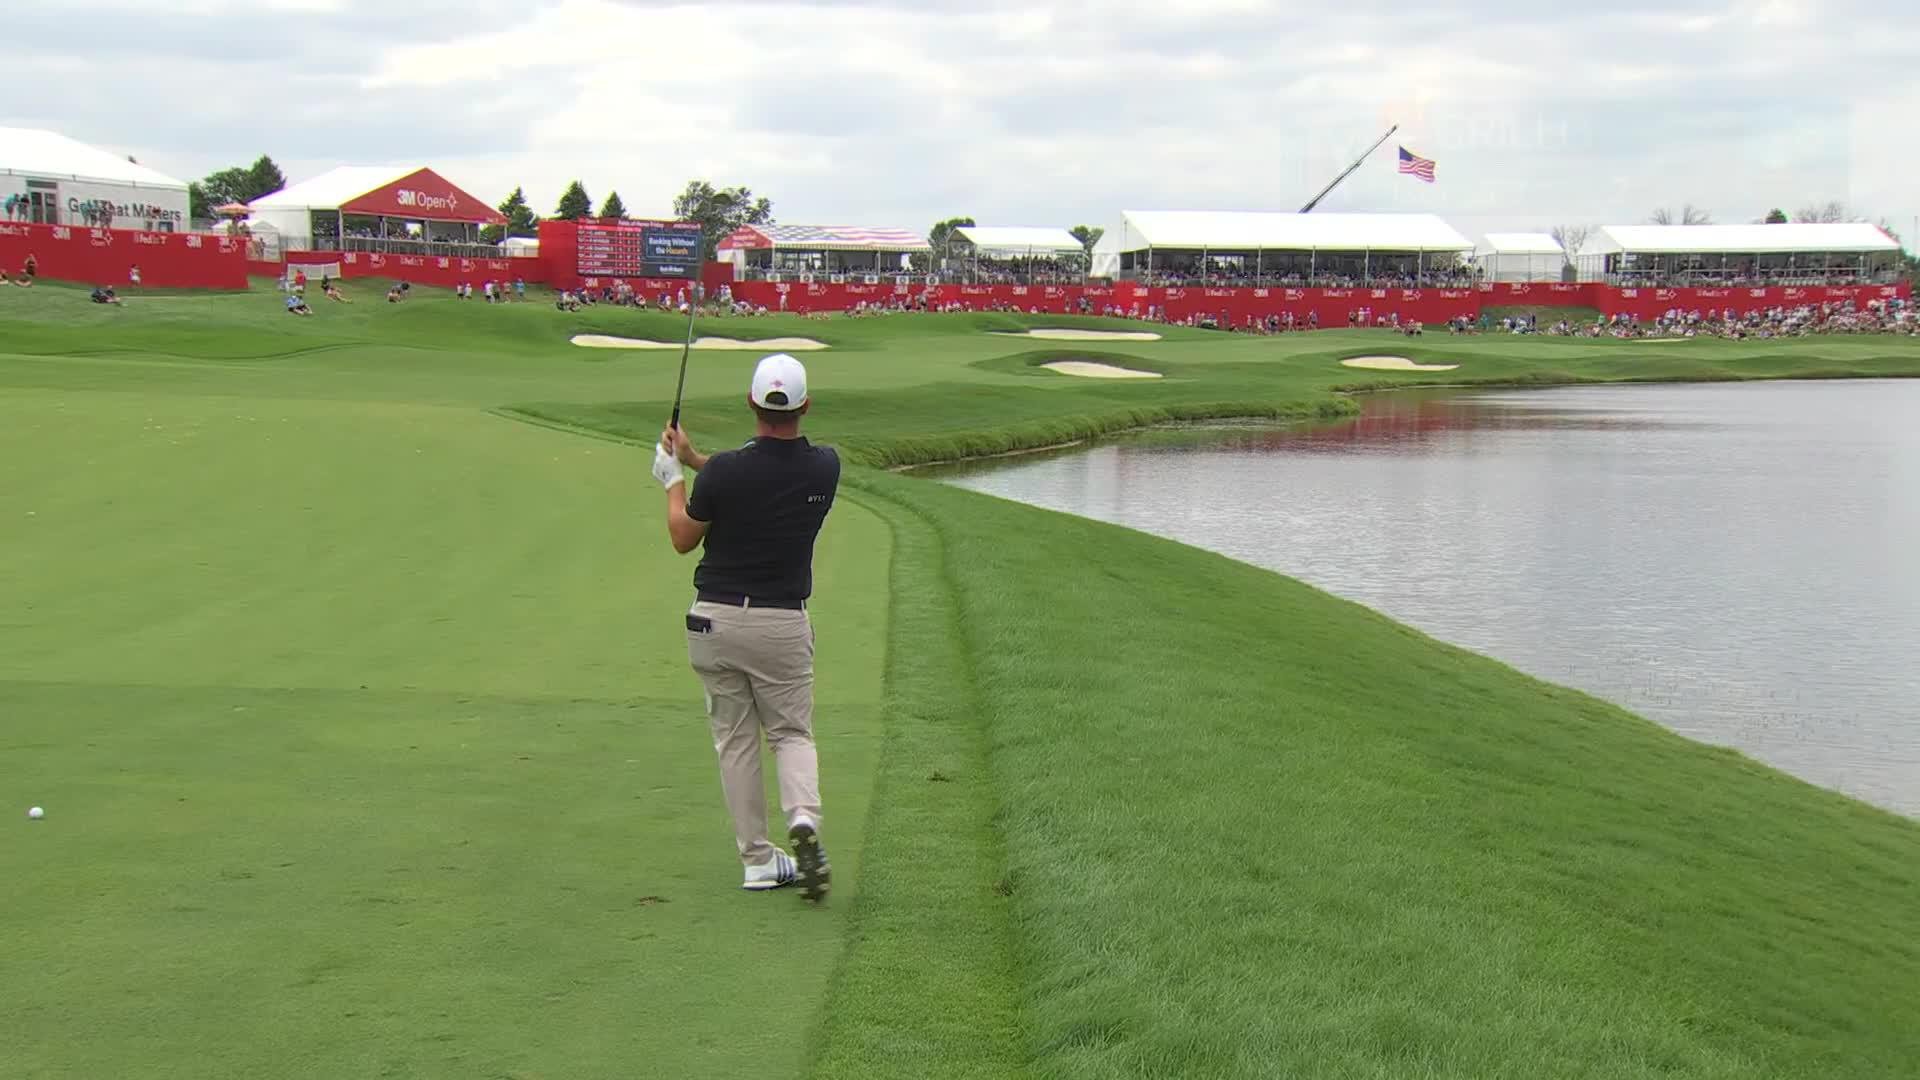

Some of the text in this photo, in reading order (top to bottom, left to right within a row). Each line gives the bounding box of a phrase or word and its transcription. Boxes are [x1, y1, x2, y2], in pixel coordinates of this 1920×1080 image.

[397, 189, 446, 210] 3M Open
[133, 203, 182, 221] Maers
[53, 225, 70, 240] 3M
[186, 235, 202, 248] 3M
